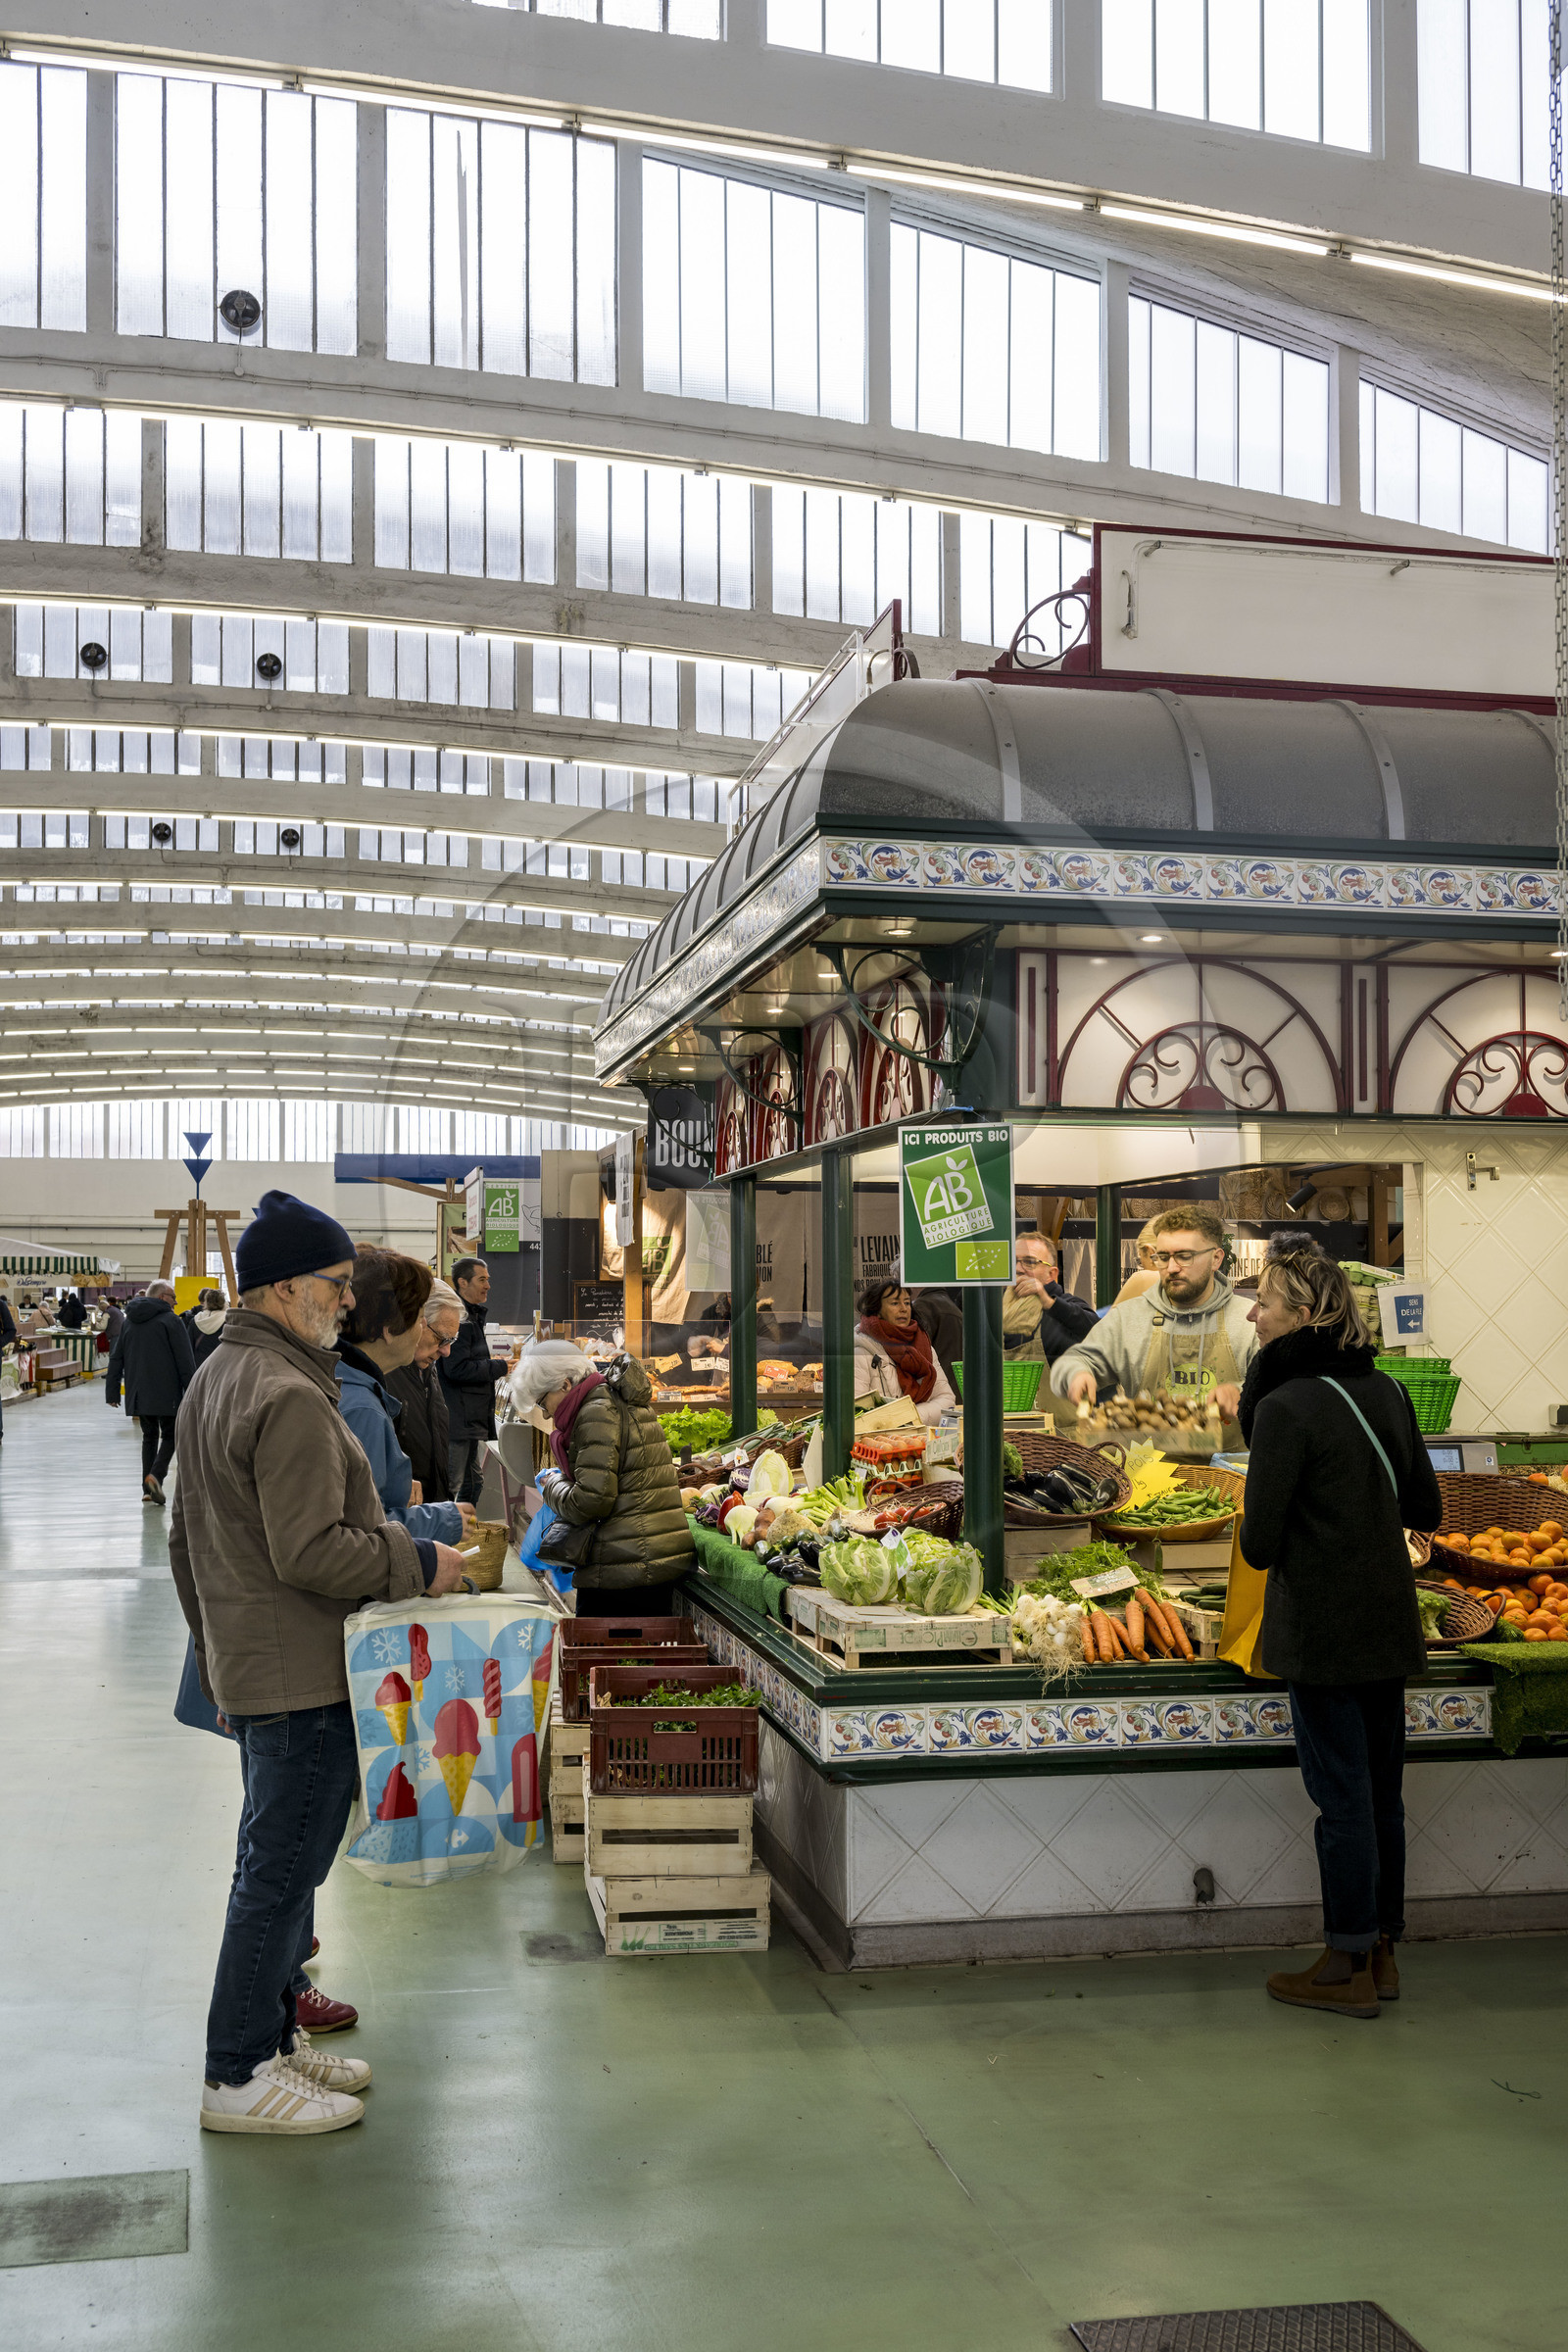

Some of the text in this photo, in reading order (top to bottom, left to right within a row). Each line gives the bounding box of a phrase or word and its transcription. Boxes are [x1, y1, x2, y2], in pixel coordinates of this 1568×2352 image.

[905, 1129, 1008, 1146] ICI PRODUITS BIO
[923, 1171, 973, 1221] AB
[488, 1197, 514, 1217] AB
[923, 1206, 990, 1236] AGRICULTURE
[925, 1216, 992, 1245] BIOLOGIQUE
[756, 1240, 773, 1264] BLÉ
[1400, 1308, 1410, 1317] DE
[1173, 1370, 1210, 1386] BIO
[1127, 1453, 1154, 1471] POIS
